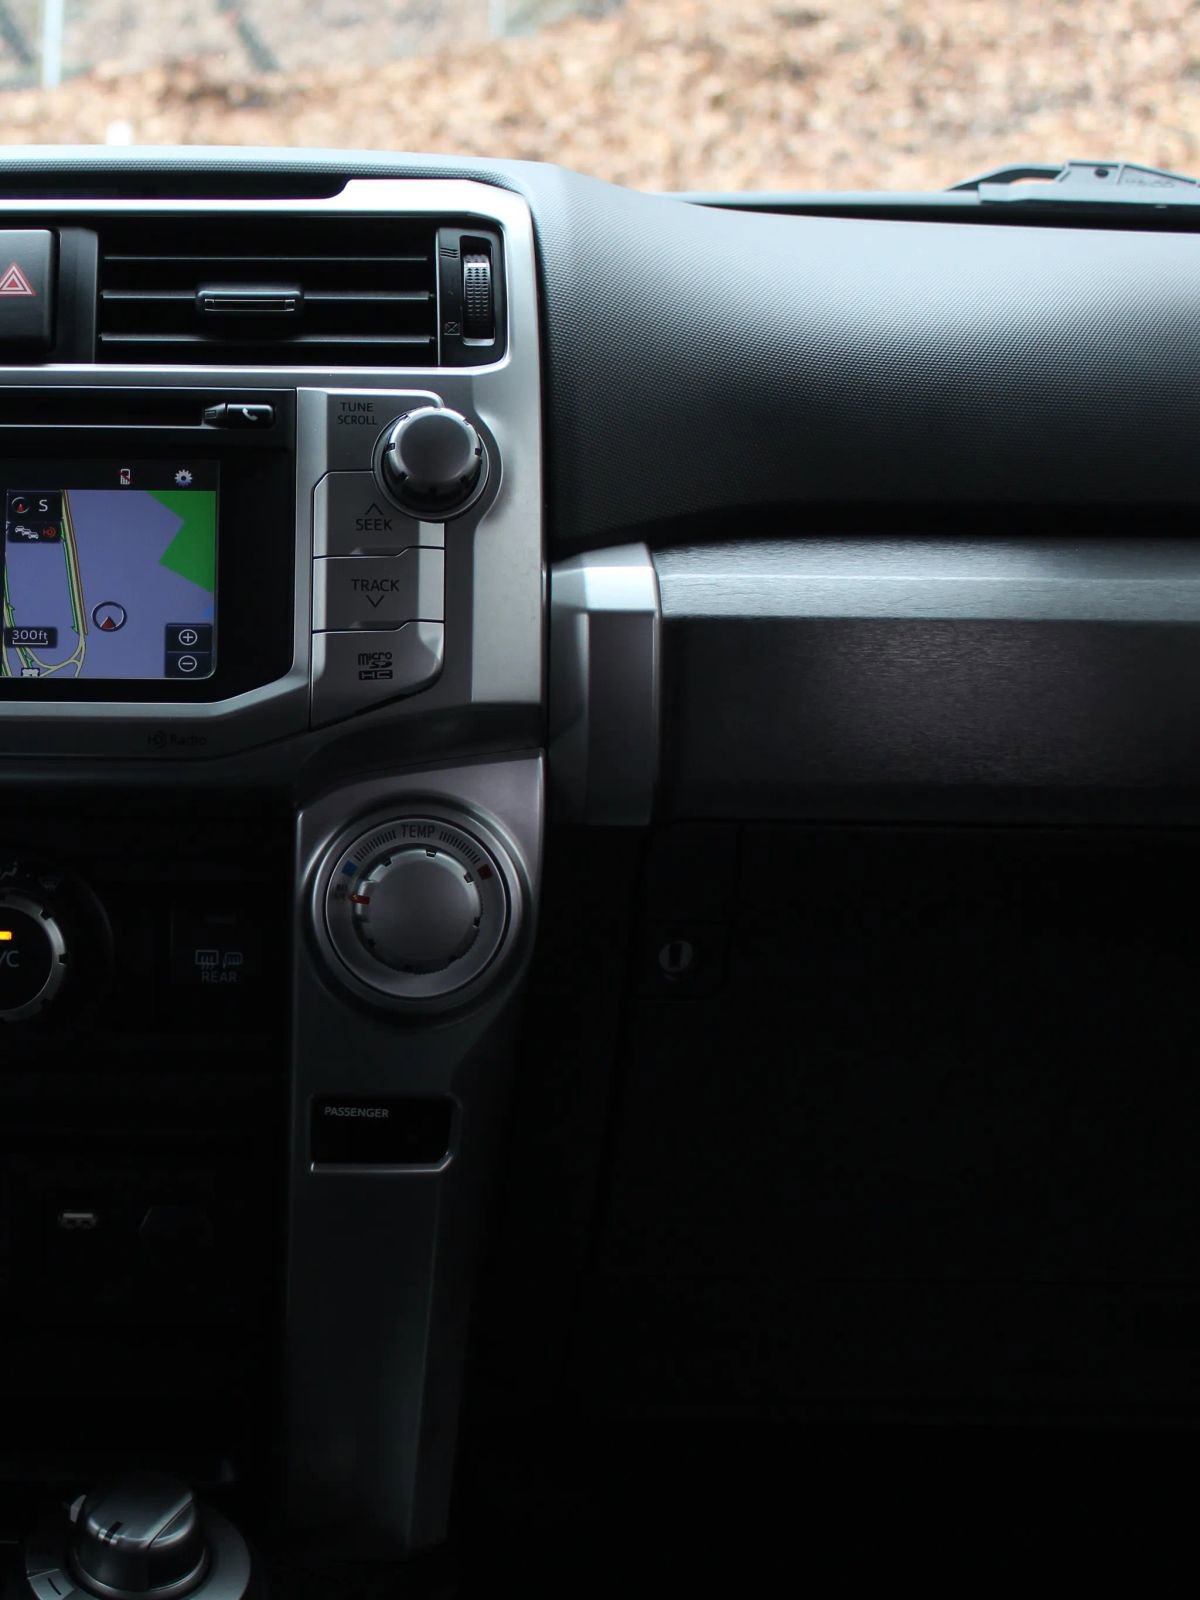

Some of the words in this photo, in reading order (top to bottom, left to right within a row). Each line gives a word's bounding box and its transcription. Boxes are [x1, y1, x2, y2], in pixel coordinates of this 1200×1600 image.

[341, 402, 374, 412] TUNE
[337, 415, 377, 425] SCROLL
[38, 499, 49, 512] S
[356, 519, 392, 531] SEEK
[352, 579, 399, 592] TRACK
[12, 630, 48, 640] 300ft
[358, 651, 392, 665] micro
[401, 824, 435, 838] TEMP
[201, 970, 240, 984] REAR
[323, 1106, 390, 1118] PASSENGER
